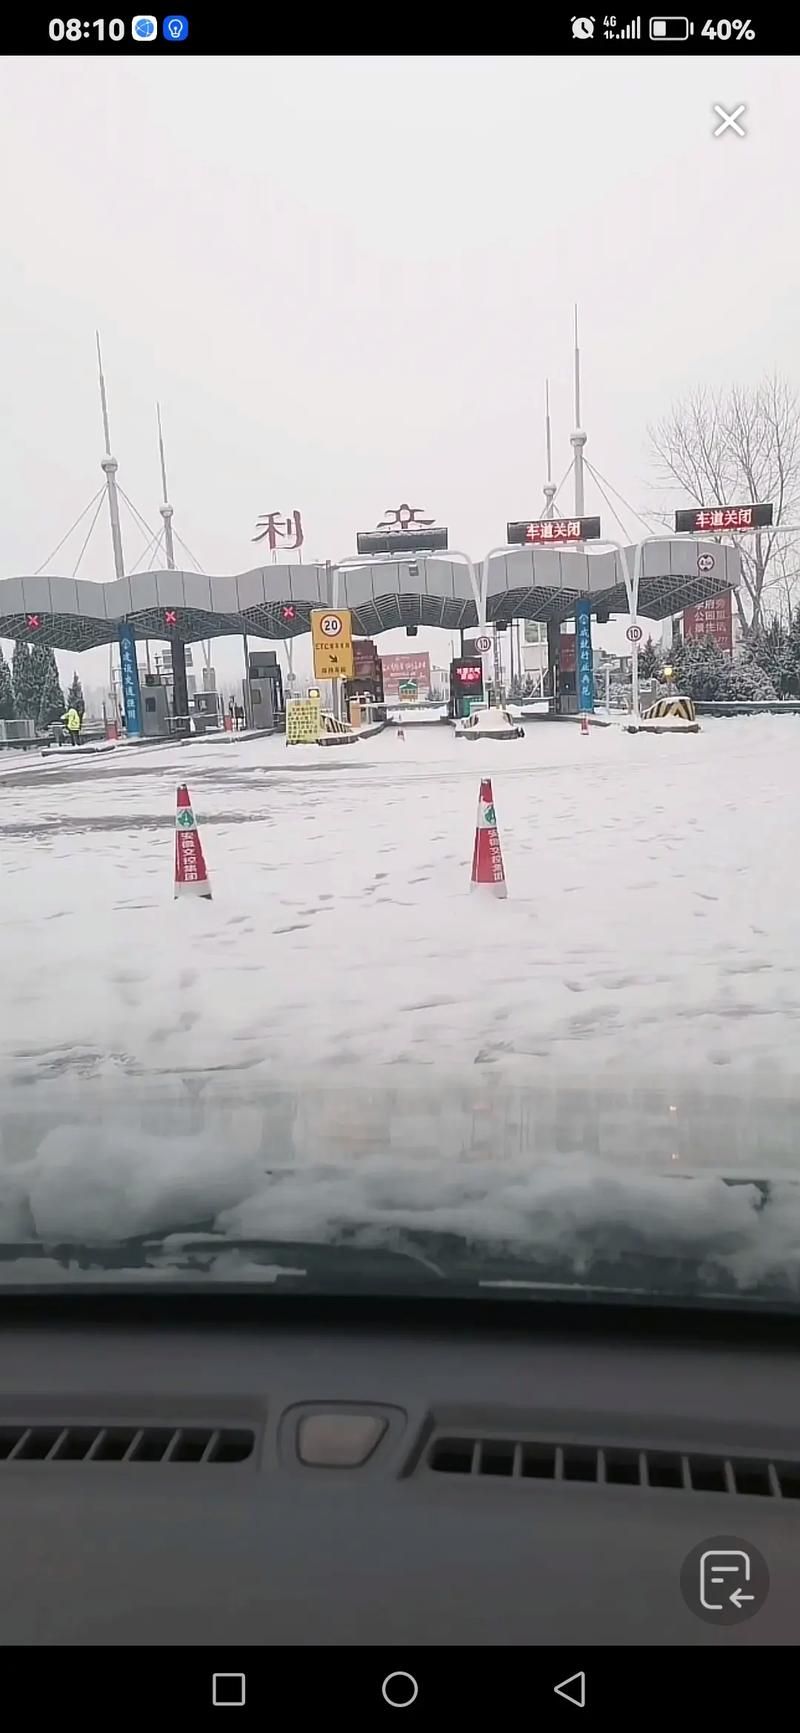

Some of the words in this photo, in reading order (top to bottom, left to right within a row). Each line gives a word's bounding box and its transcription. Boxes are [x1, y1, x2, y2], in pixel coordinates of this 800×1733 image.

[695, 509, 752, 528] 车道关闭
[526, 521, 581, 540] 车道关闭
[324, 620, 338, 631] 20
[630, 629, 639, 639] 10
[480, 639, 488, 649] 10
